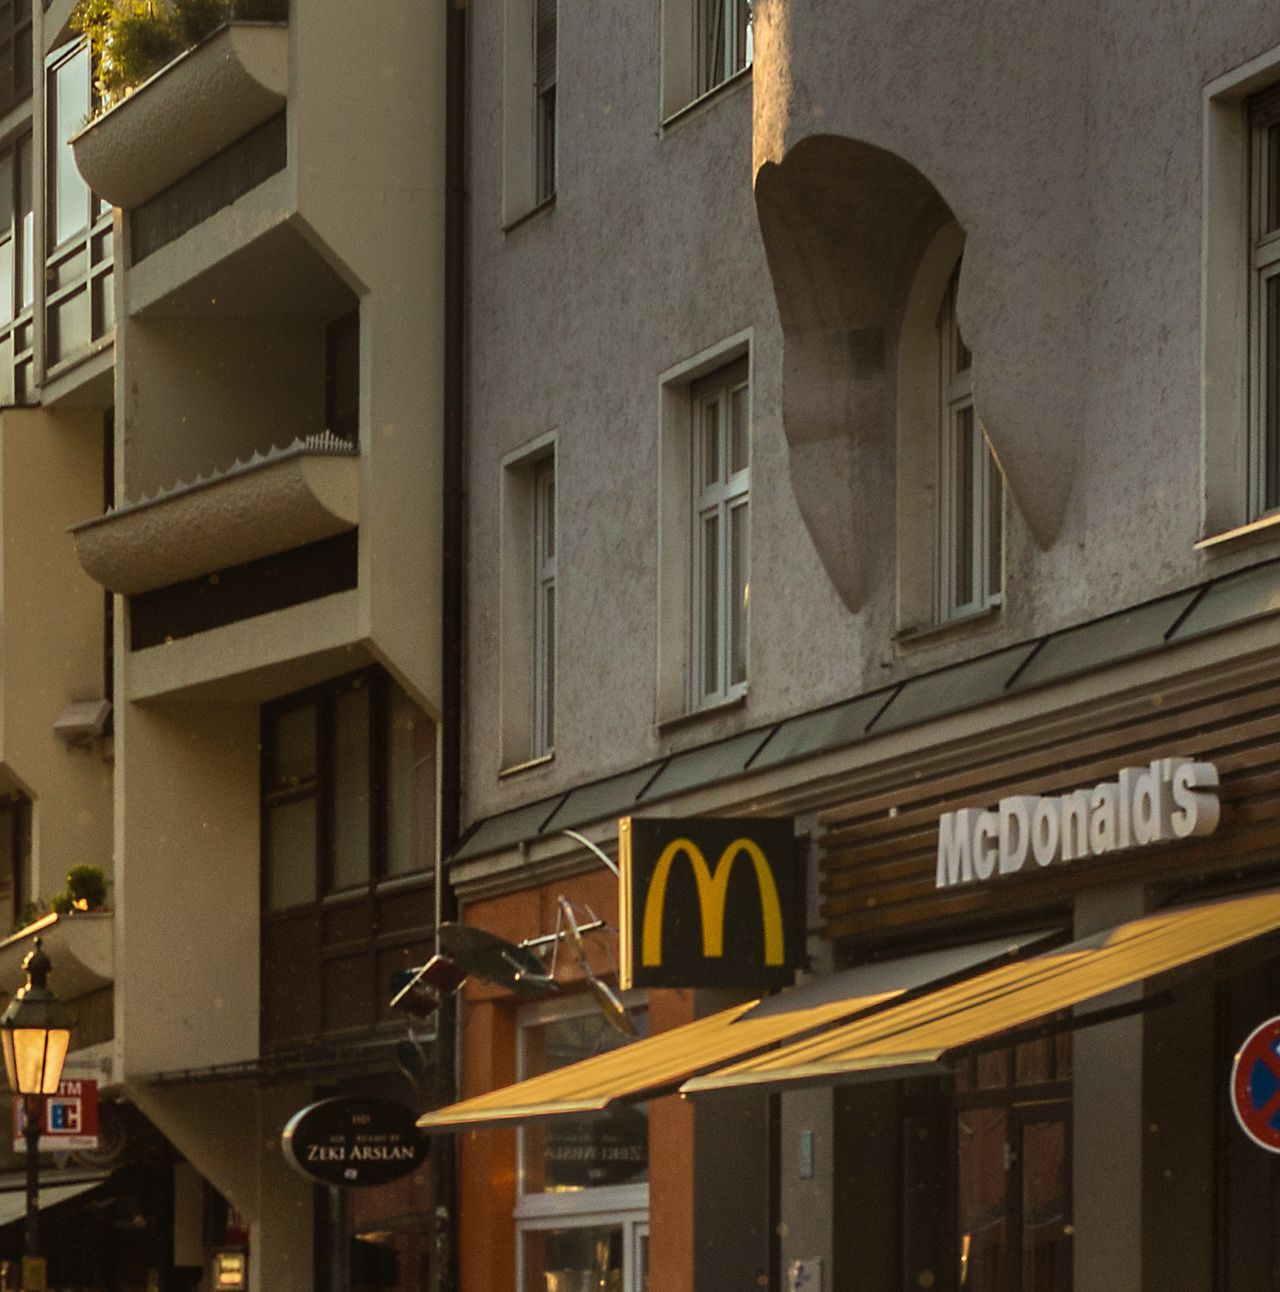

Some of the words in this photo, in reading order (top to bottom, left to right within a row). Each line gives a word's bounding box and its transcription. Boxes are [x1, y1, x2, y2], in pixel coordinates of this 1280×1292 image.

[936, 757, 1221, 889] McDonald's
[57, 1081, 82, 1096] TM
[307, 1144, 345, 1161] ZEKI
[350, 1144, 415, 1161] ARSLAN
